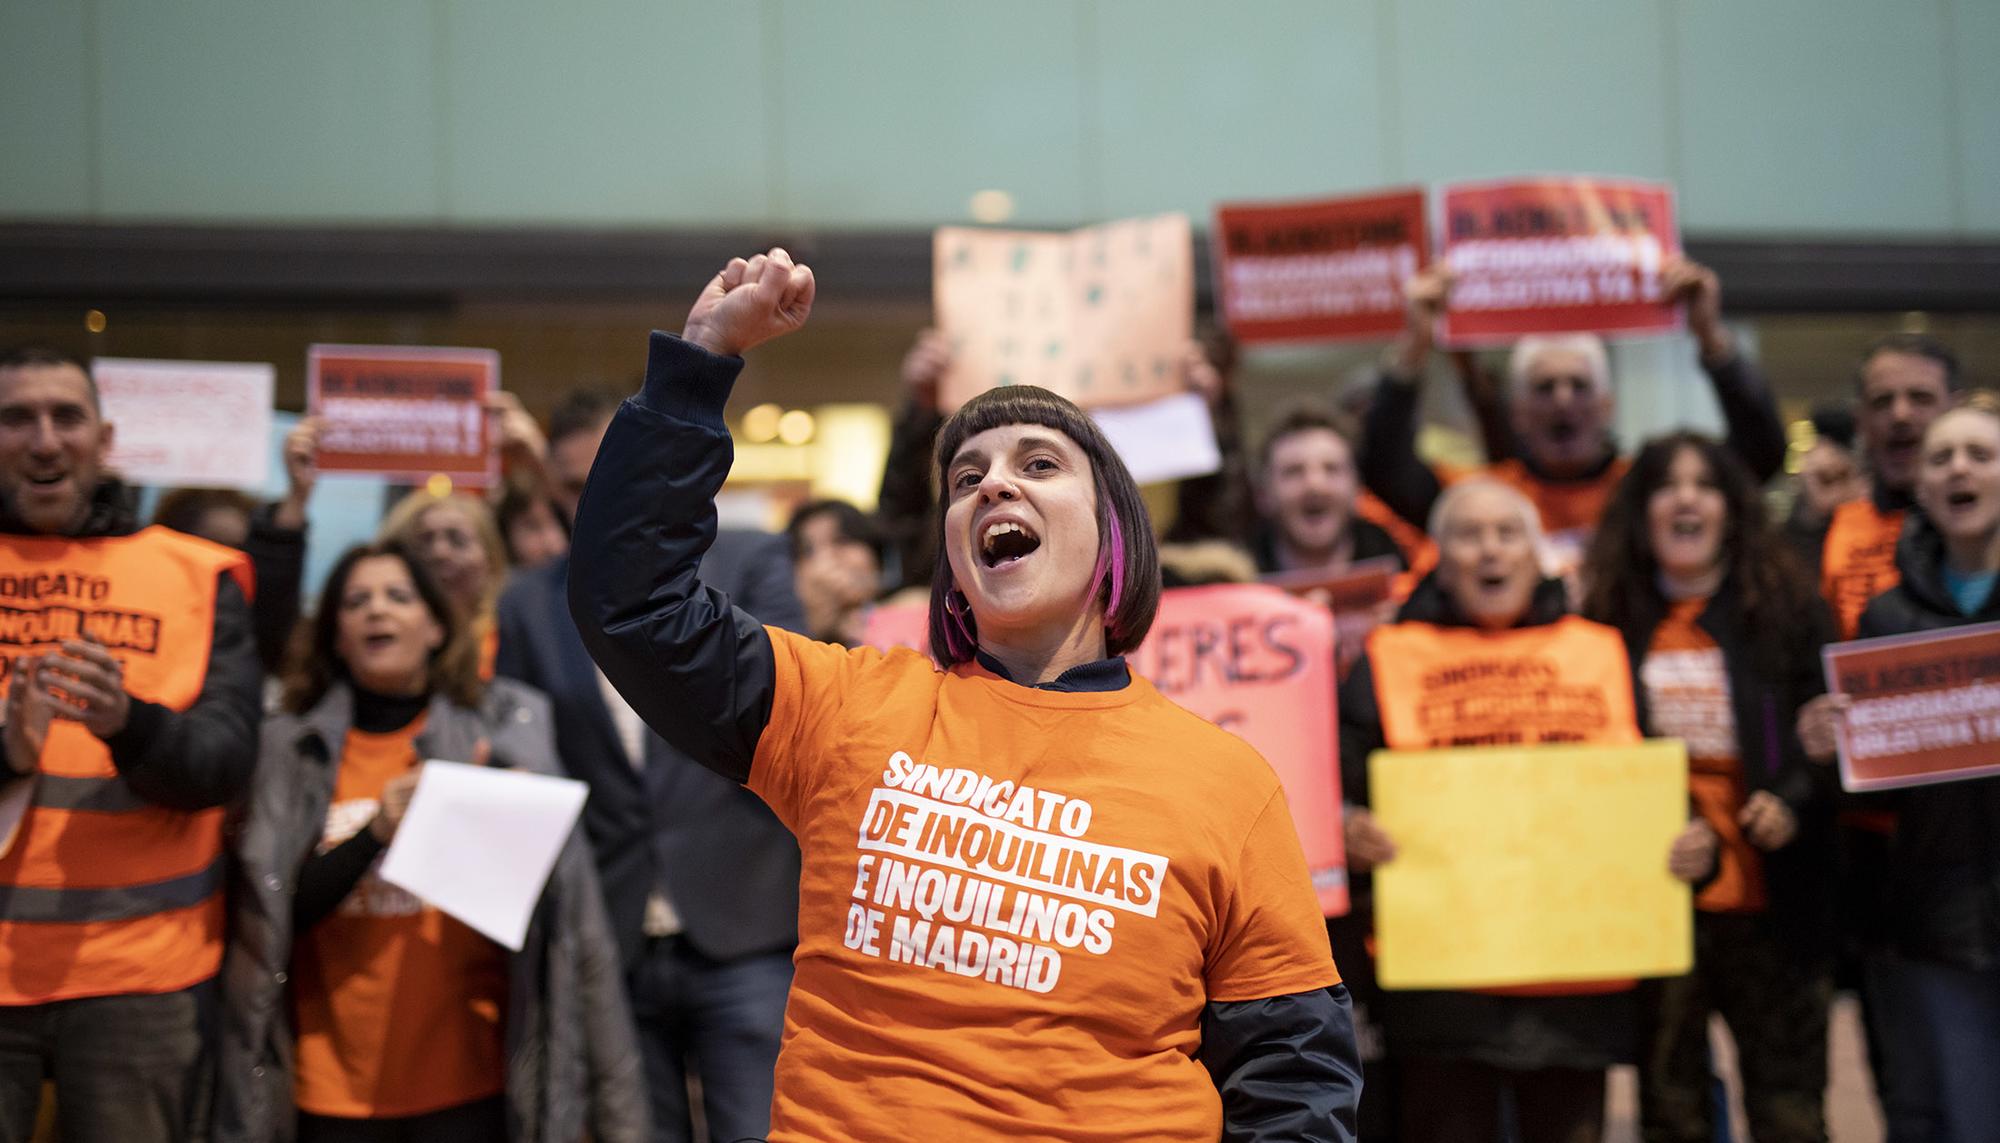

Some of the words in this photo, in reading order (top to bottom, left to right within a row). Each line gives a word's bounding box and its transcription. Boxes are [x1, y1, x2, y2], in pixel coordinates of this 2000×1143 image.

[883, 751, 1093, 838] SINDICATO
[866, 800, 919, 847] DE
[916, 811, 1156, 906] INQUILINAS
[843, 903, 885, 958] DE
[888, 916, 1062, 994] MADRID
[852, 855, 876, 901] E
[874, 857, 1115, 955] INQUILINOS
